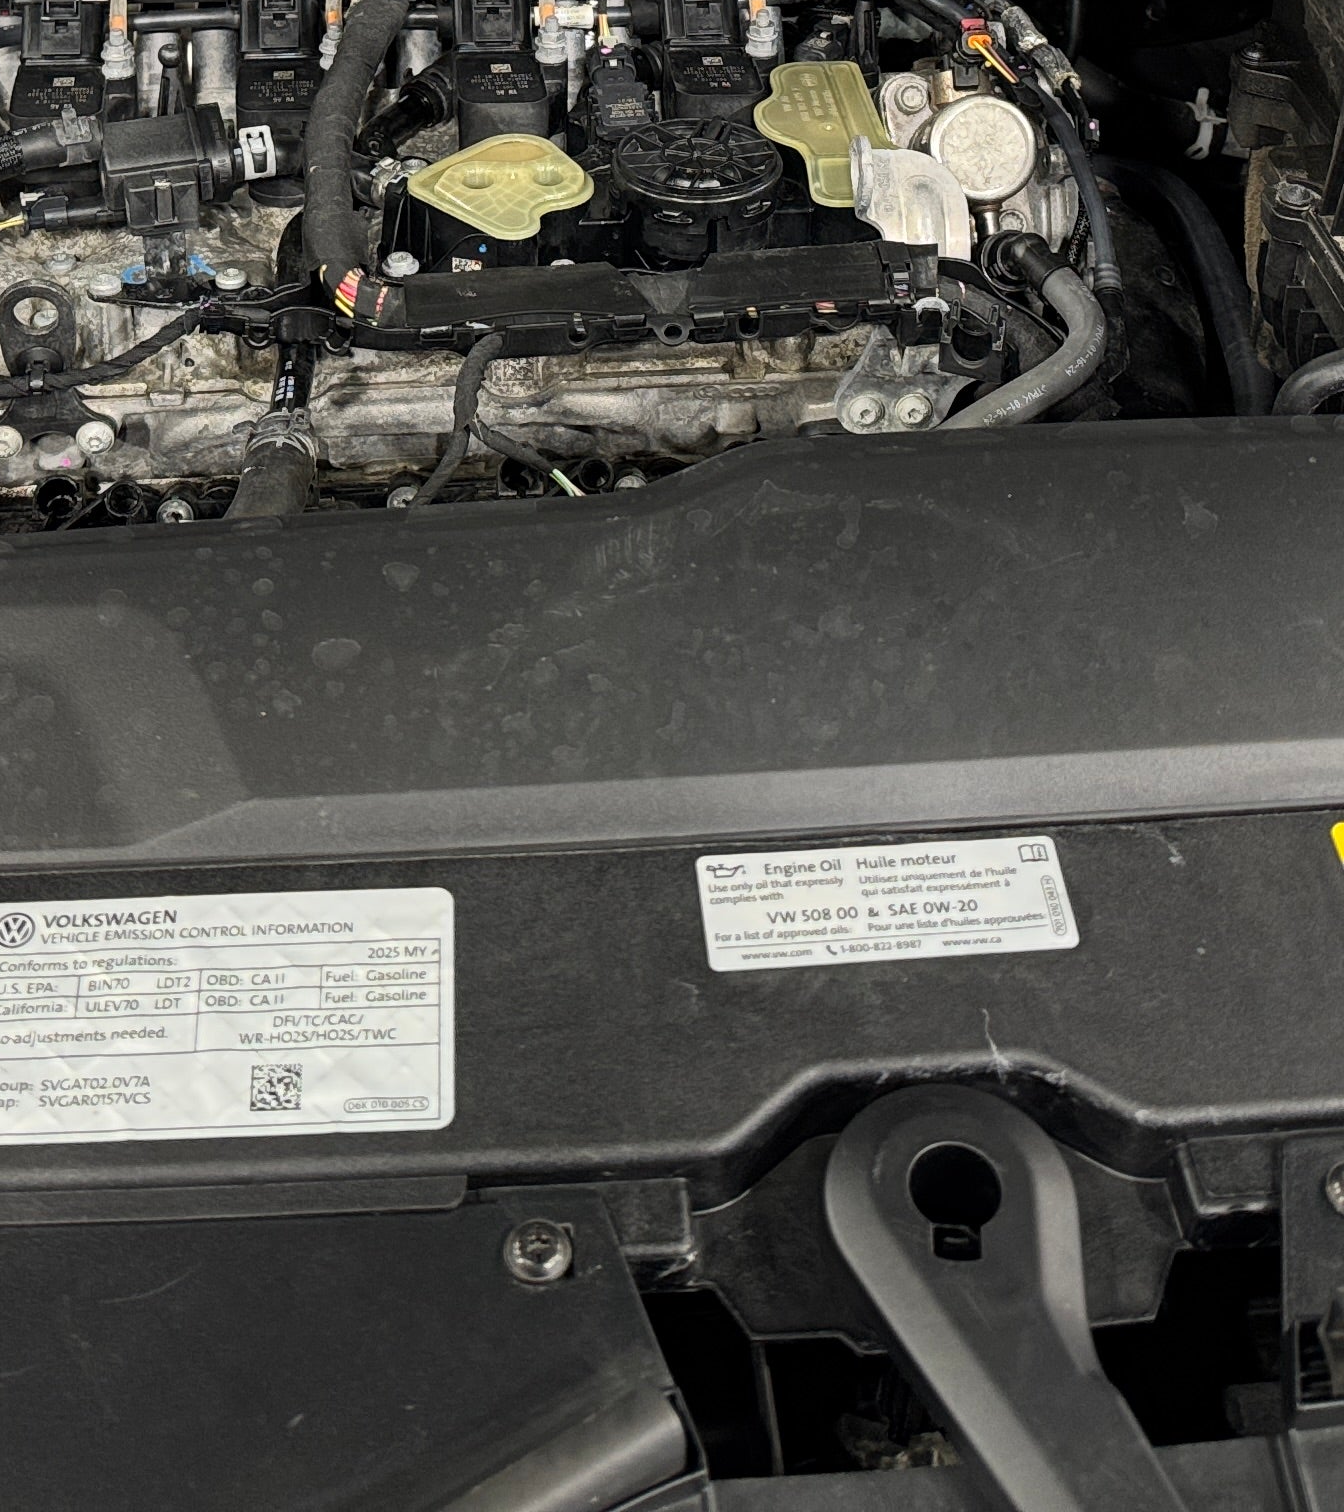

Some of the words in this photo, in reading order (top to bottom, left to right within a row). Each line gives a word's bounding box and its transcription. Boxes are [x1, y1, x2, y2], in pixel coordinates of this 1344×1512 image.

[764, 861, 816, 877] Engine
[820, 858, 842, 872] Oil
[856, 856, 896, 869] Huile
[900, 854, 956, 867] moteur
[708, 883, 729, 893] Use
[730, 881, 753, 892] only
[756, 879, 768, 889] oil
[770, 878, 792, 888] that
[795, 876, 844, 888] expressly
[859, 873, 898, 884] Utilisez
[901, 870, 967, 883] uniquement
[969, 867, 983, 878] de
[709, 893, 757, 905] complies
[759, 891, 784, 901] with
[861, 886, 879, 898] qui
[881, 883, 923, 895] satisfait
[1004, 878, 1011, 887] à
[42, 909, 177, 929] VOLKSWAGEN
[766, 910, 796, 924] VW
[801, 908, 832, 922] 508
[836, 906, 859, 919] 00
[867, 906, 880, 917] &
[888, 902, 918, 916] SAE
[923, 899, 978, 914] 0W-20
[41, 931, 99, 945] VEHICLE
[105, 928, 175, 942] EMISSION
[179, 925, 247, 939] CONTROL
[252, 922, 354, 936] INFORMATION
[714, 932, 732, 943] For
[734, 932, 742, 941] a
[744, 930, 760, 941] list
[762, 929, 774, 939] of
[777, 926, 827, 940] approved
[868, 921, 892, 932] Pour
[895, 920, 915, 931] une
[917, 918, 939, 929] liste
[73, 958, 88, 970] to
[92, 954, 177, 970] regulations:
[368, 946, 400, 959] 2025
[404, 945, 427, 958] MY
[27, 981, 58, 994] EPA:
[88, 977, 130, 992] BIN70
[156, 975, 191, 989] LDT2
[206, 973, 244, 986] OBD:
[251, 972, 271, 985] CA
[366, 966, 427, 982] Gasoline
[86, 999, 139, 1013] ULEV70
[154, 997, 181, 1010] LDT
[205, 995, 242, 1007] OBD:
[250, 994, 270, 1006] CA
[365, 988, 427, 1002] Gasoline
[14, 1029, 106, 1048] adjustments
[111, 1026, 168, 1040] needed.
[273, 1014, 364, 1028] DFI/TC/CAC/
[239, 1028, 397, 1045] WR-HO2S/HO2S/TWC
